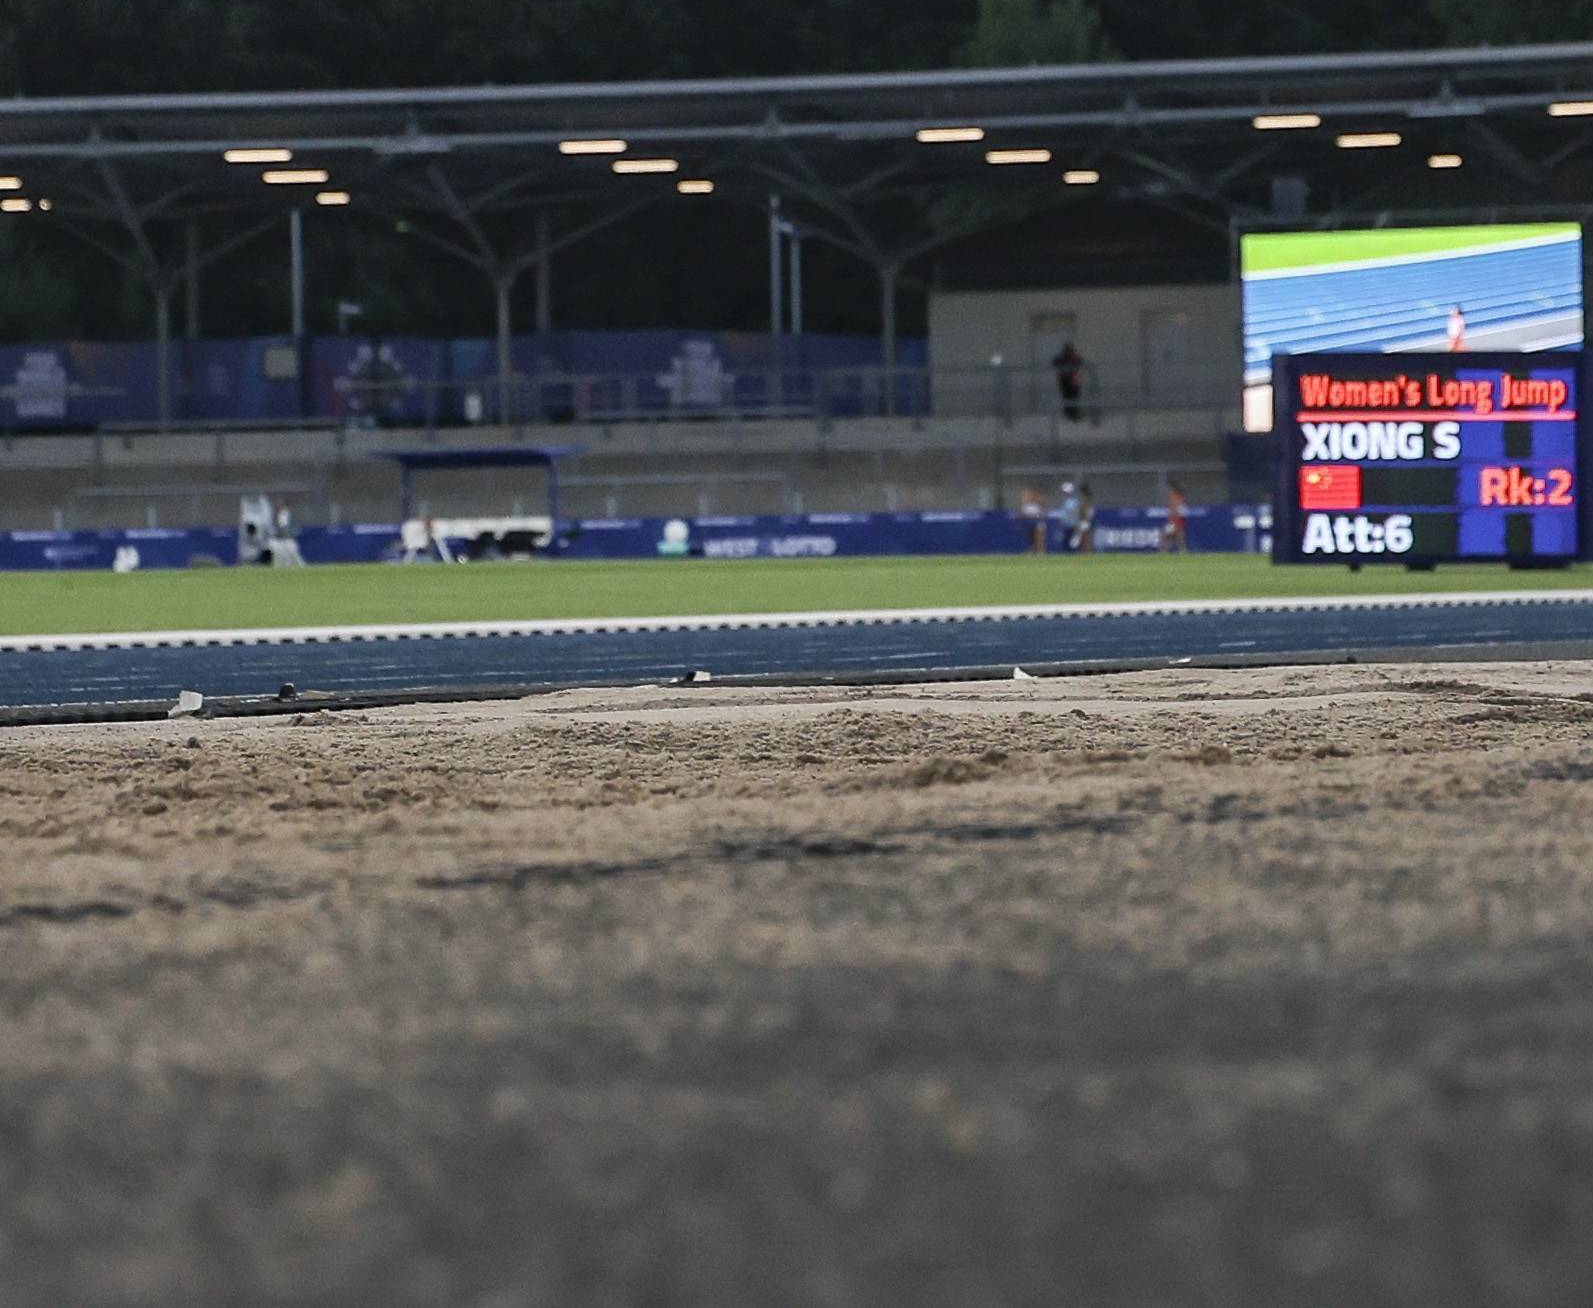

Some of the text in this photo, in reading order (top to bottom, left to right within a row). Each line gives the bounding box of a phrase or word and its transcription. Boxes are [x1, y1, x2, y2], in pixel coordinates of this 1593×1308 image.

[1300, 373, 1566, 414] Women's Long Jump
[1301, 421, 1461, 461] XIONG S
[1480, 466, 1574, 506] Rk:2
[1302, 514, 1414, 554] Att:6
